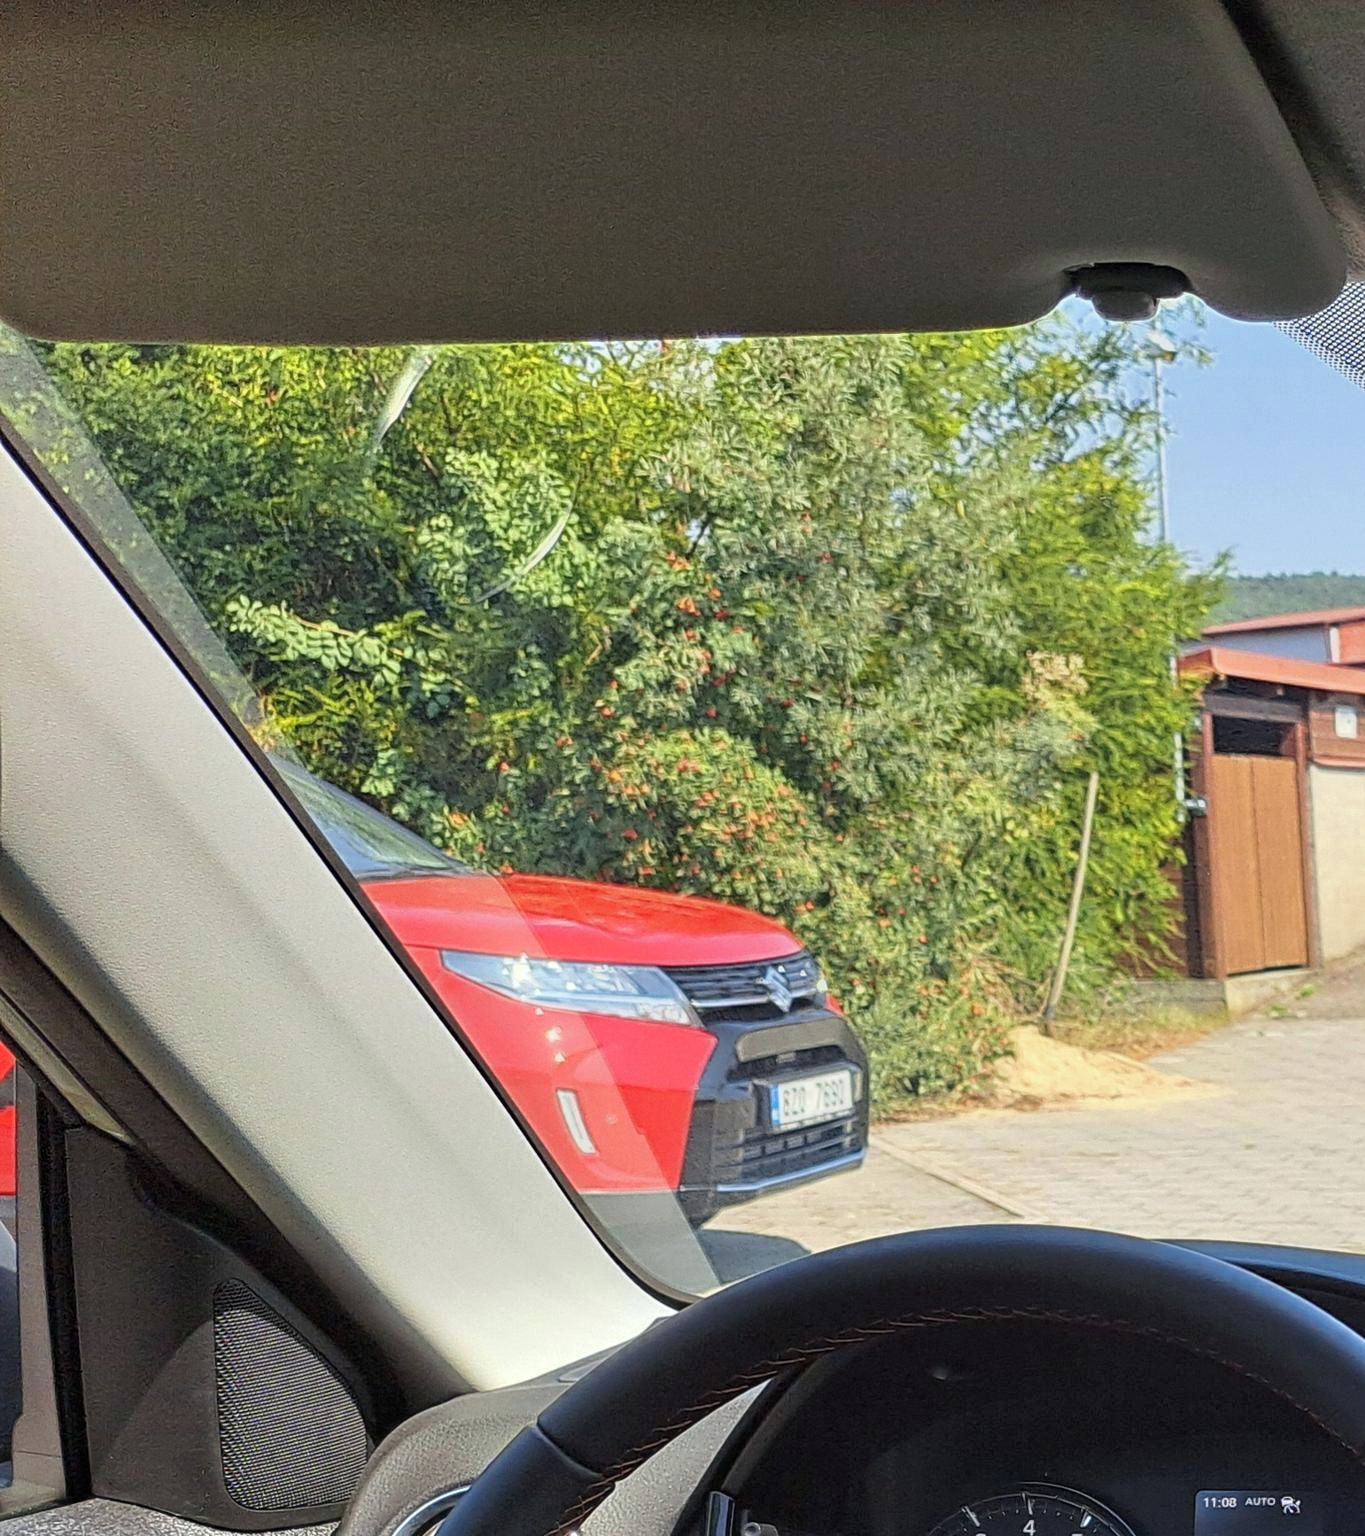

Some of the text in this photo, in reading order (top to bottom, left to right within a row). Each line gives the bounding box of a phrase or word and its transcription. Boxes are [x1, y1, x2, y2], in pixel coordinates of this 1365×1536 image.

[1203, 1497, 1275, 1508] 11:08 AUTO
[1023, 1520, 1036, 1536] 4
